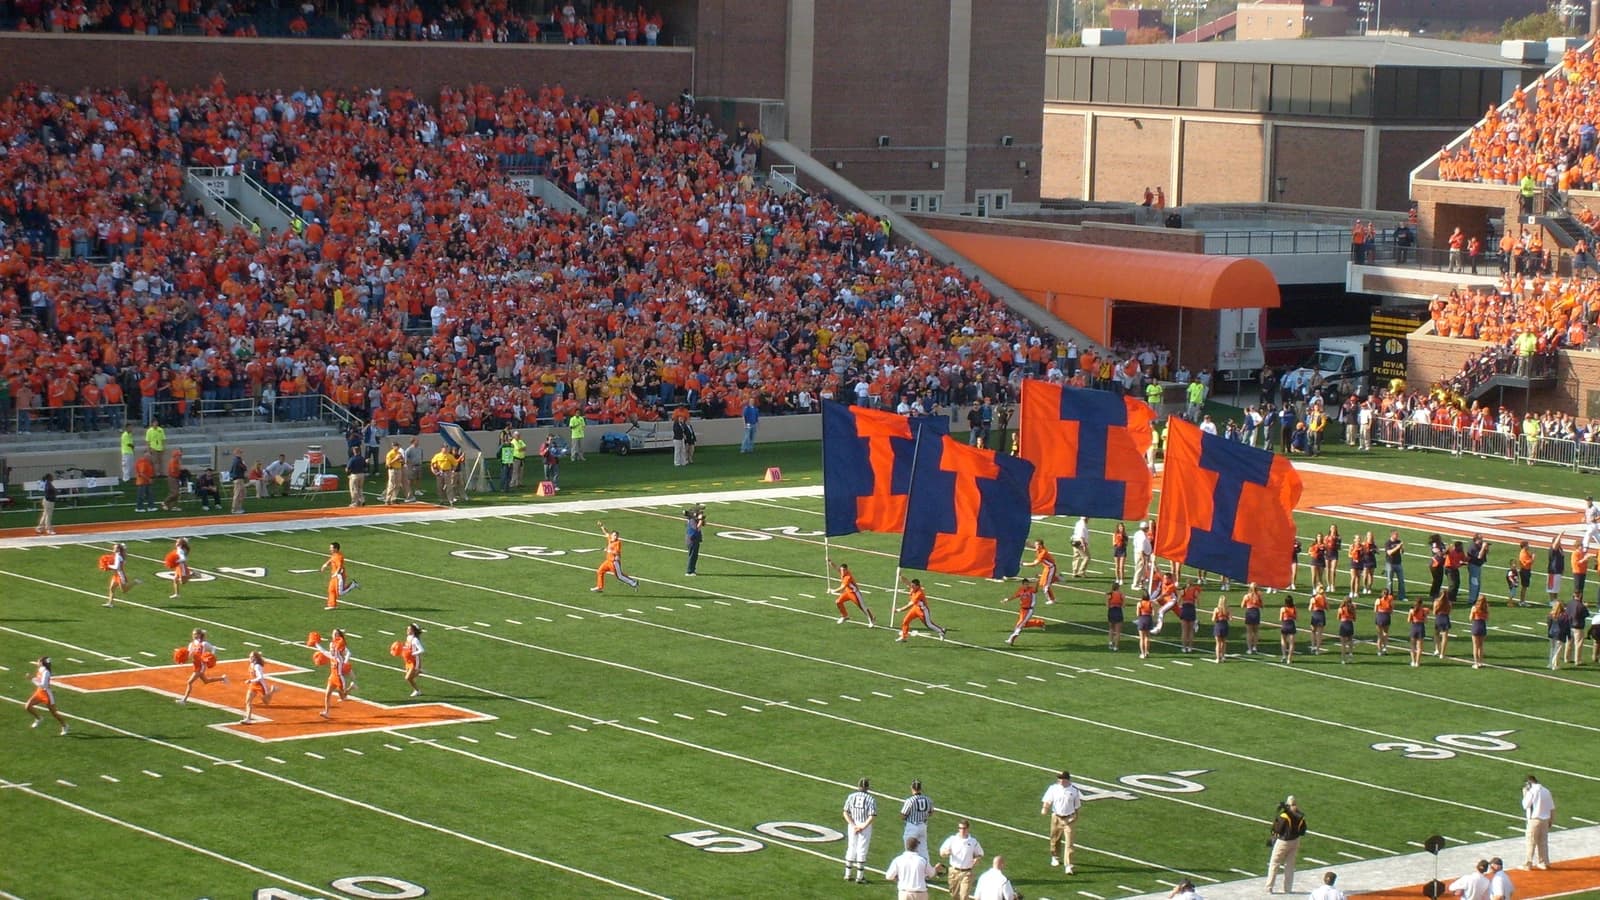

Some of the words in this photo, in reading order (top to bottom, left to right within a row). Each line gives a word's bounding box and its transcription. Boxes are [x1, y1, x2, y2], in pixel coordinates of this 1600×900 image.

[1383, 360, 1405, 370] IOWA
[1373, 367, 1408, 377] FOOTBAL
[544, 484, 554, 495] 20
[1370, 733, 1519, 760] 30
[665, 821, 845, 854] 50
